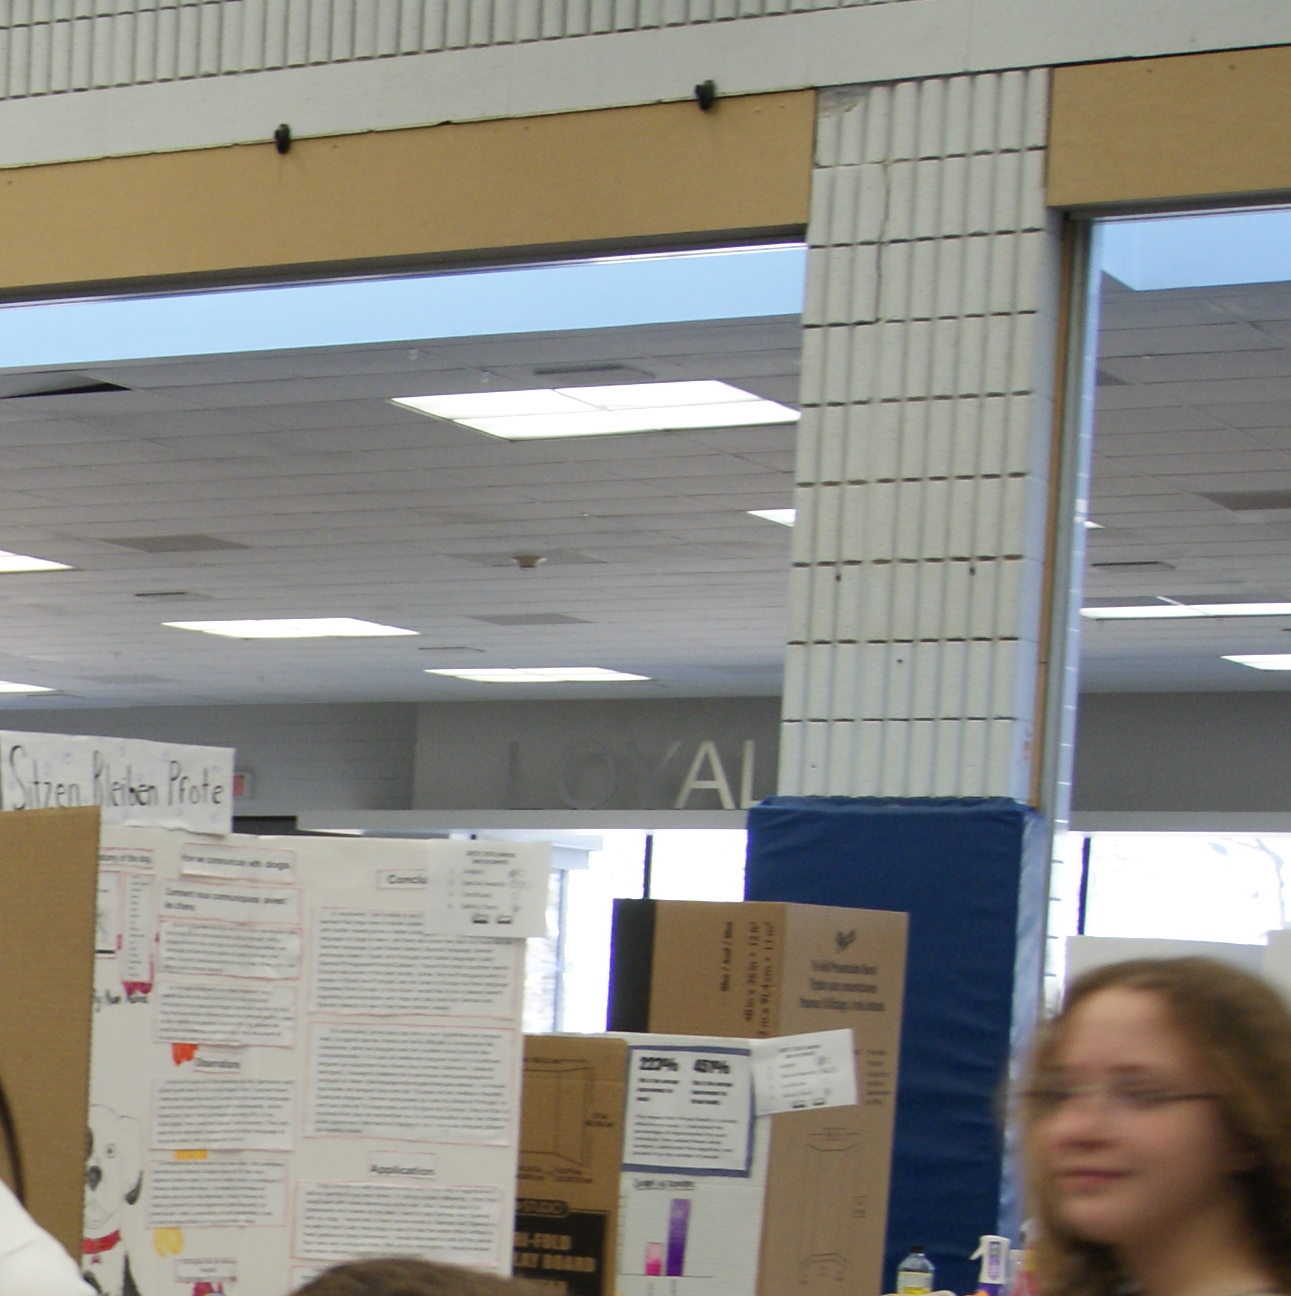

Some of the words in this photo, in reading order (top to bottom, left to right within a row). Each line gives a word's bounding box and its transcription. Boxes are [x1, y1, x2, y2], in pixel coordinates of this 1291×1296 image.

[9, 744, 81, 809] Sitzen
[168, 759, 225, 806] Pfote
[370, 1164, 435, 1176] Application
